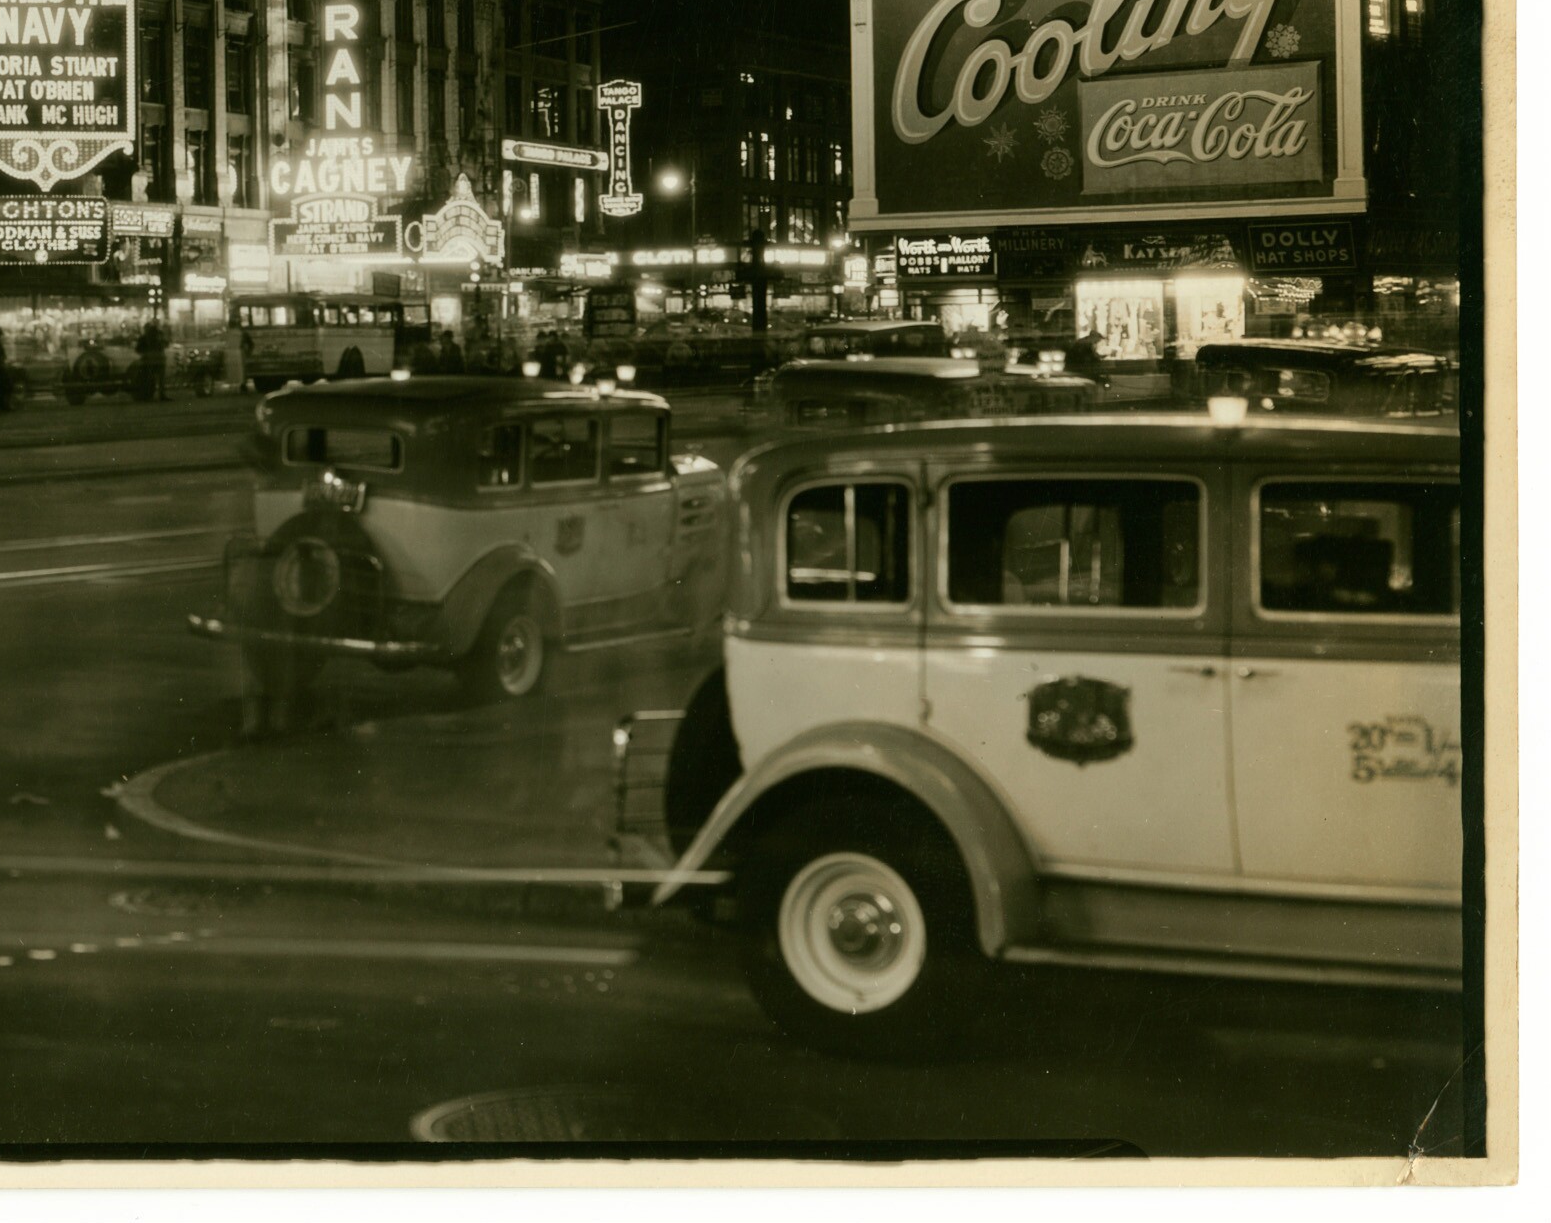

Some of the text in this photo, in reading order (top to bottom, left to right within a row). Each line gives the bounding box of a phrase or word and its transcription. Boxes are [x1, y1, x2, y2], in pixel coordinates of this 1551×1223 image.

[50, 55, 119, 79] STUART
[30, 79, 95, 102] O'BRIEN
[602, 87, 638, 96] TANGO
[599, 96, 640, 106] PALACE
[1142, 93, 1206, 110] DRINK
[42, 104, 67, 126] MC
[72, 104, 119, 127] HUGH
[614, 109, 627, 193] DANCING
[271, 156, 412, 195] CAGNEY
[299, 198, 369, 224] STRAND
[55, 226, 66, 240] &
[69, 225, 102, 240] SUSS
[1262, 230, 1339, 248] DOLLY
[1, 239, 79, 251] CLOTHES
[898, 235, 992, 255] Worth Worth
[999, 238, 1065, 251] MILLINERY
[899, 256, 940, 266] DOBBS
[948, 255, 990, 265] MALLORY
[1256, 249, 1349, 264] HAT SHOPS
[908, 266, 931, 275] HATS
[957, 264, 981, 273] HATS
